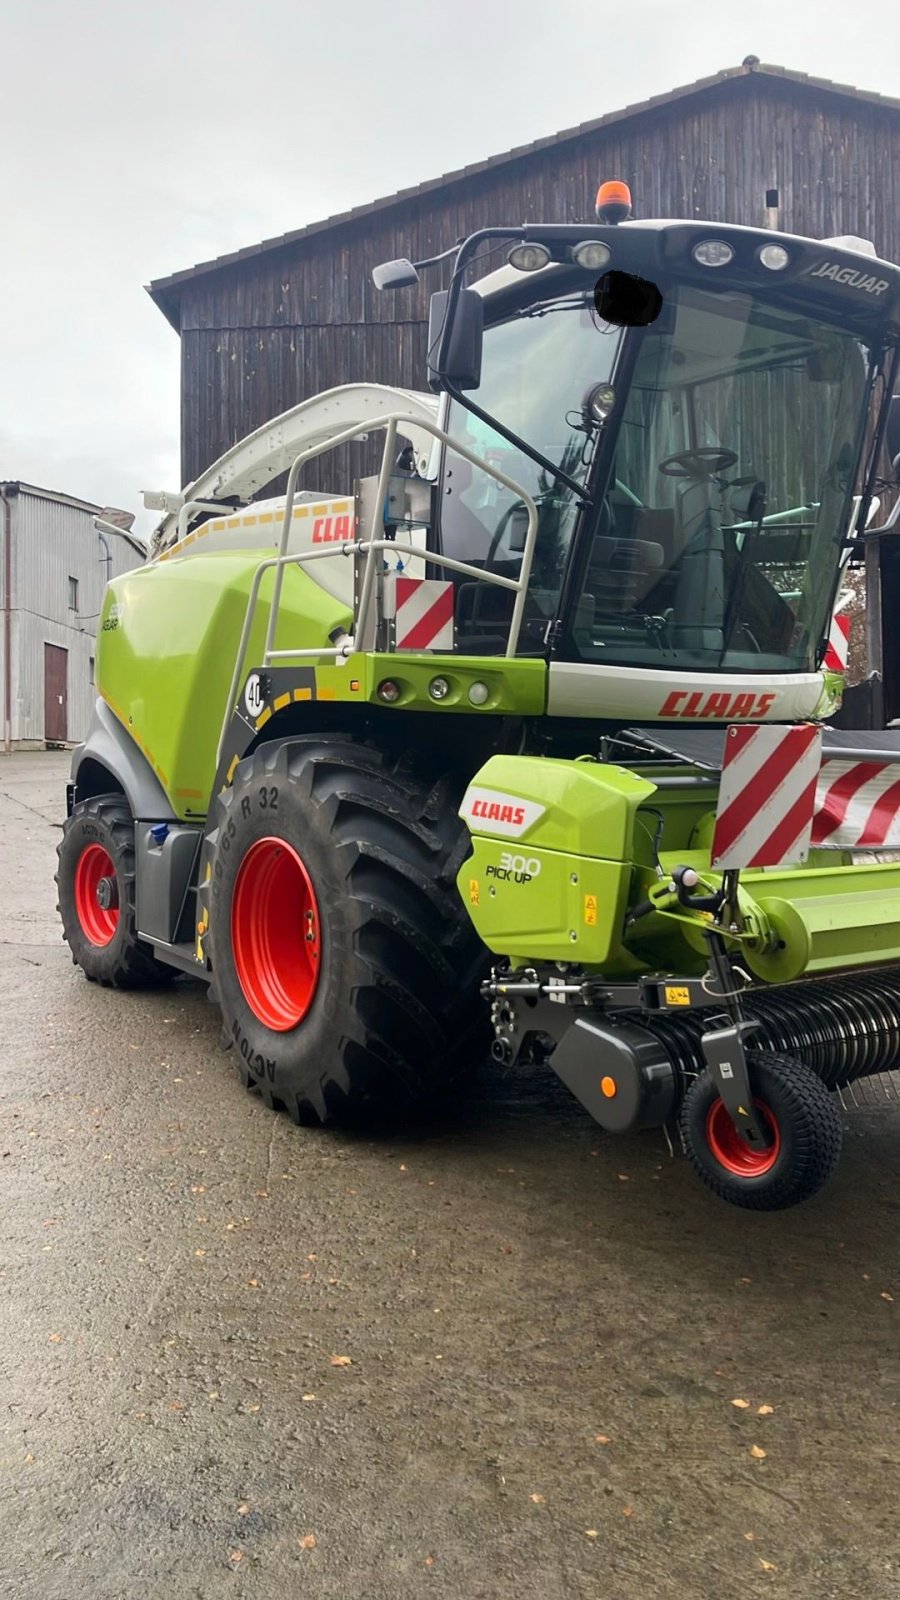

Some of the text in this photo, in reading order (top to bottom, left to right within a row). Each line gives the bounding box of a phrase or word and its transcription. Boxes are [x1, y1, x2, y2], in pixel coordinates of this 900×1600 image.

[811, 262, 890, 296] JAGUAR
[248, 681, 260, 707] 40
[657, 691, 776, 718] CLAAS
[241, 795, 251, 820] R
[259, 786, 279, 810] 32
[471, 800, 525, 825] CLAAS
[485, 865, 532, 884] PICK UP
[499, 852, 542, 877] 300
